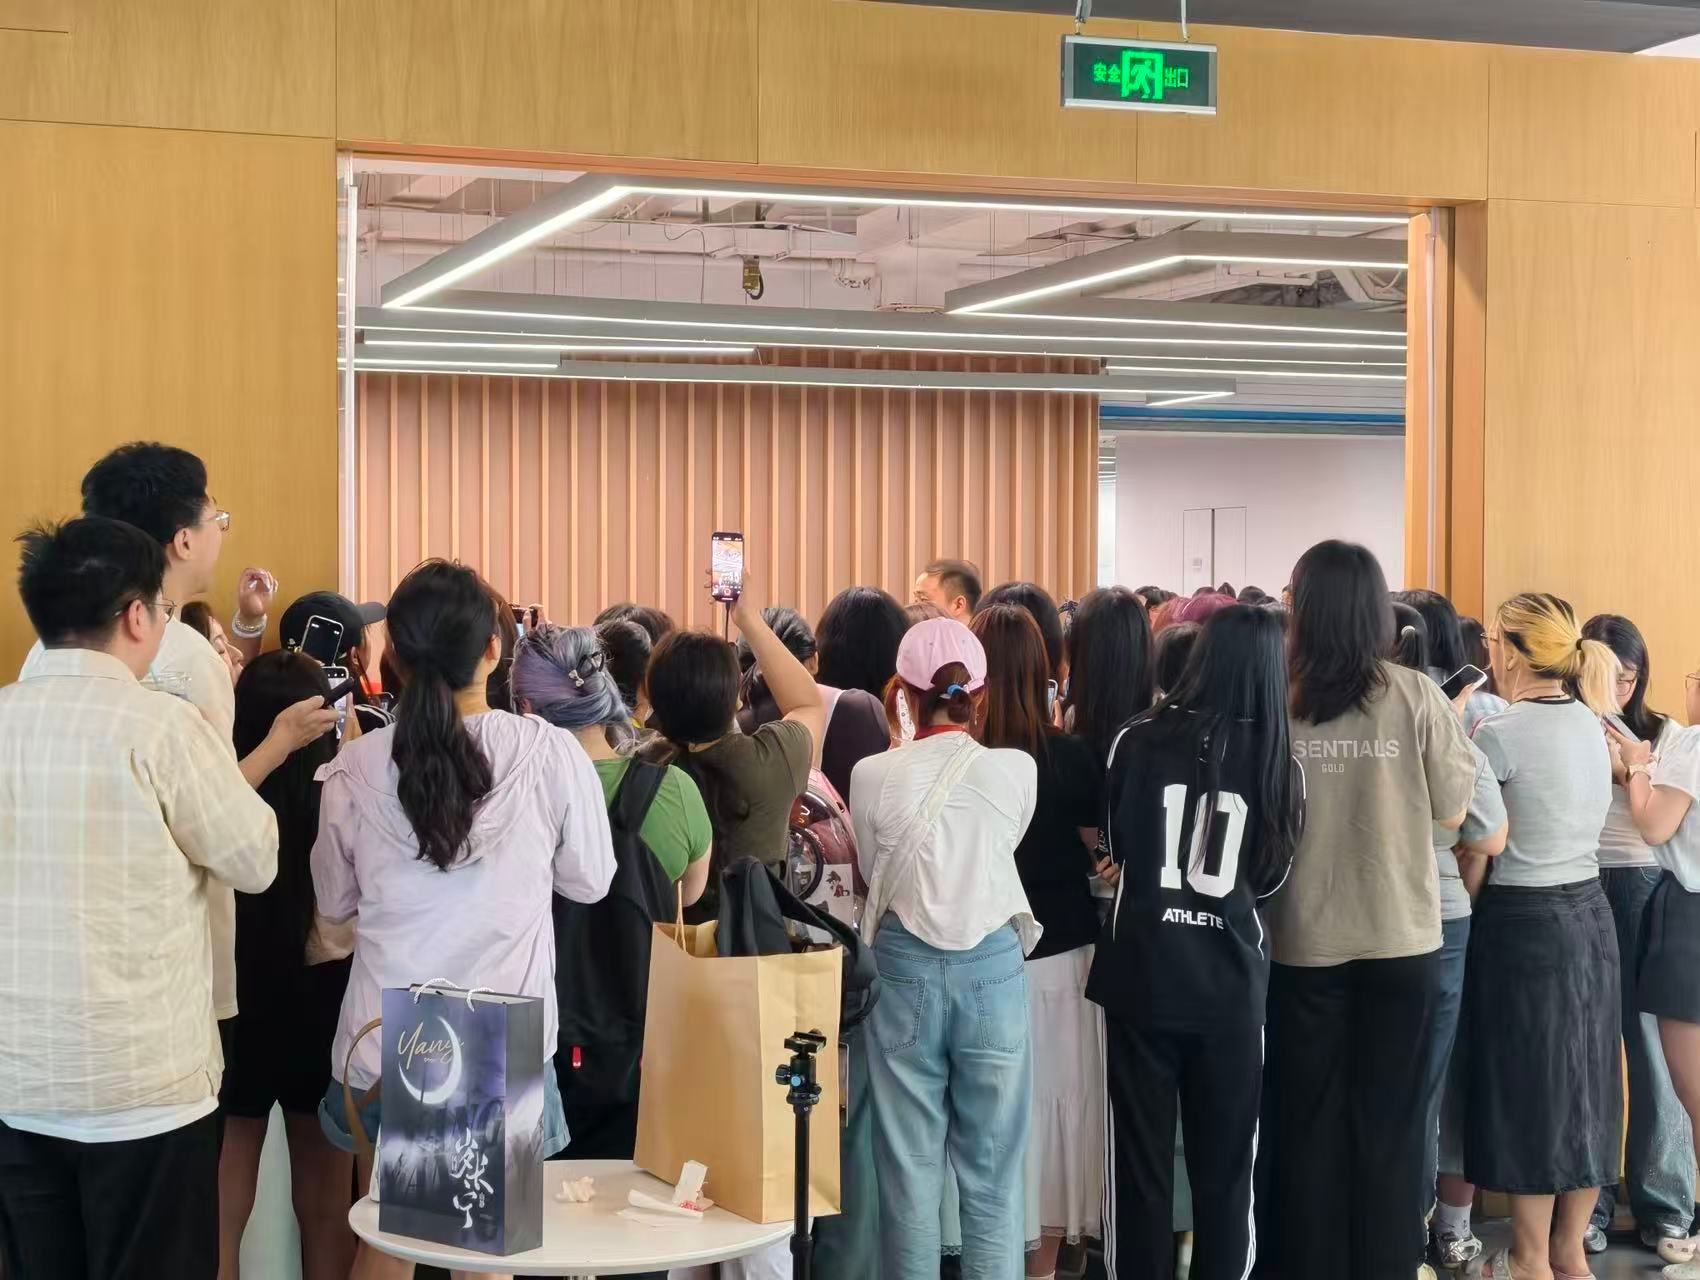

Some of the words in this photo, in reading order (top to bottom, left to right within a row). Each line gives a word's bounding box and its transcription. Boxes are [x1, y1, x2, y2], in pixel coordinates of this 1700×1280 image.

[1093, 62, 1121, 83] 安全
[1165, 67, 1189, 88] 出口
[1321, 763, 1345, 773] GOLD
[1161, 784, 1248, 898] 10
[1162, 908, 1224, 929] ATHLETE
